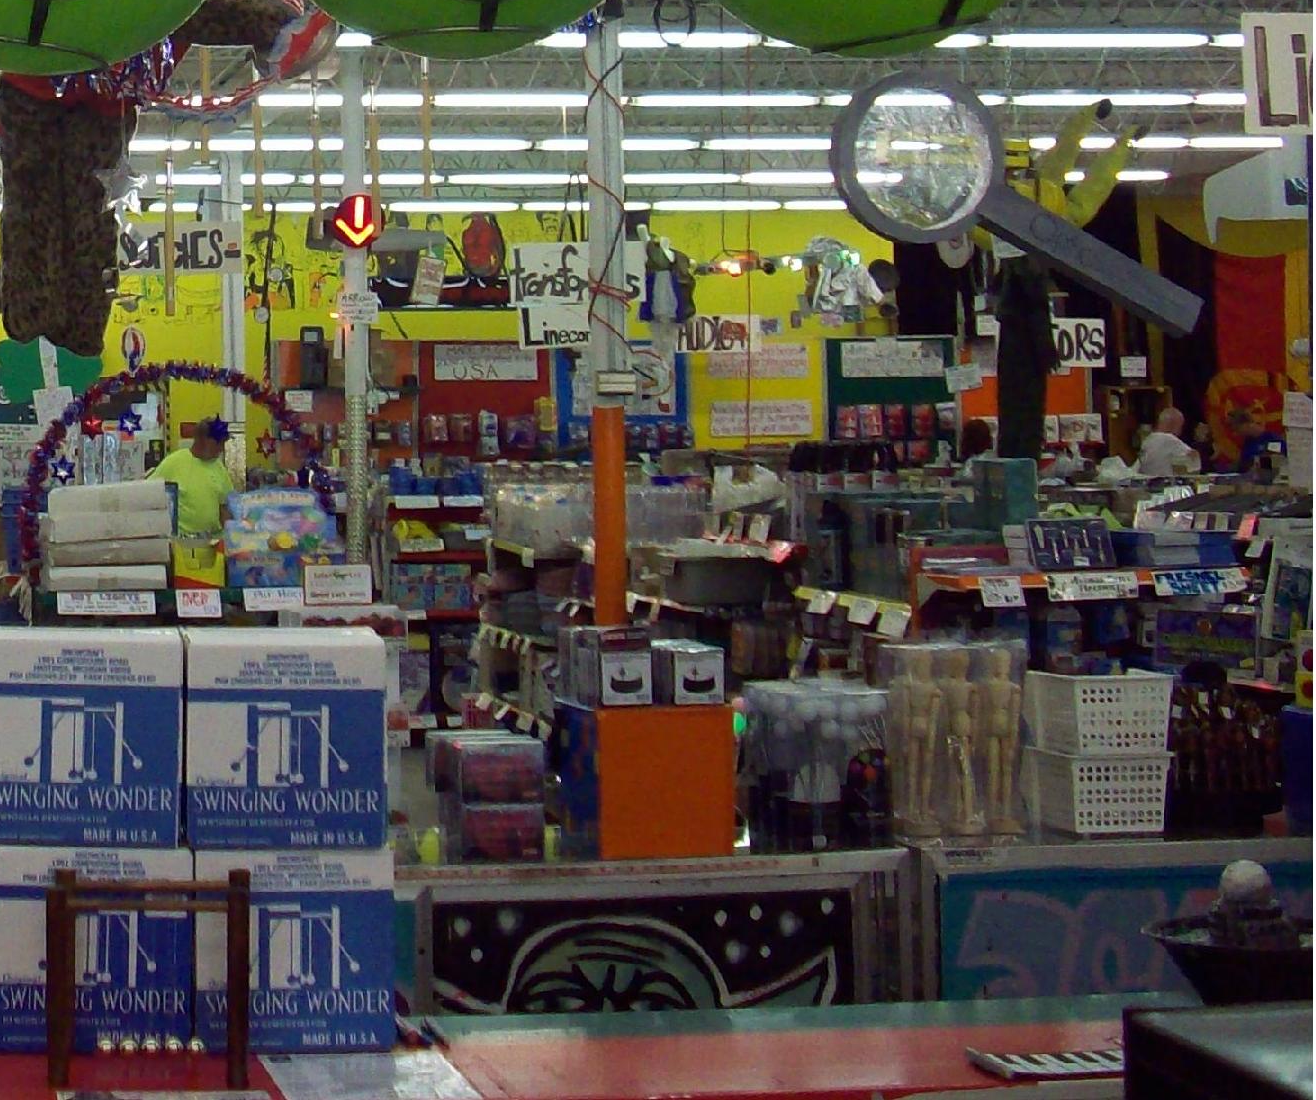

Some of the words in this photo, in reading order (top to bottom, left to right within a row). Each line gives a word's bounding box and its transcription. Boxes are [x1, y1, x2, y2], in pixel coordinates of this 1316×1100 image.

[1254, 26, 1313, 127] Li
[88, 784, 172, 811] WONDER
[193, 787, 285, 813] SWINGING
[295, 789, 380, 813] WONDER
[84, 828, 111, 842] MADE
[116, 829, 127, 842] IN
[290, 831, 318, 845] MADE
[323, 831, 333, 845] IN
[0, 986, 93, 1011] SWING
[102, 988, 186, 1014] WONDER
[206, 990, 298, 1015] SWGING
[307, 990, 390, 1015] WONDER
[303, 1033, 331, 1046] MADE
[336, 1033, 345, 1046] IN
